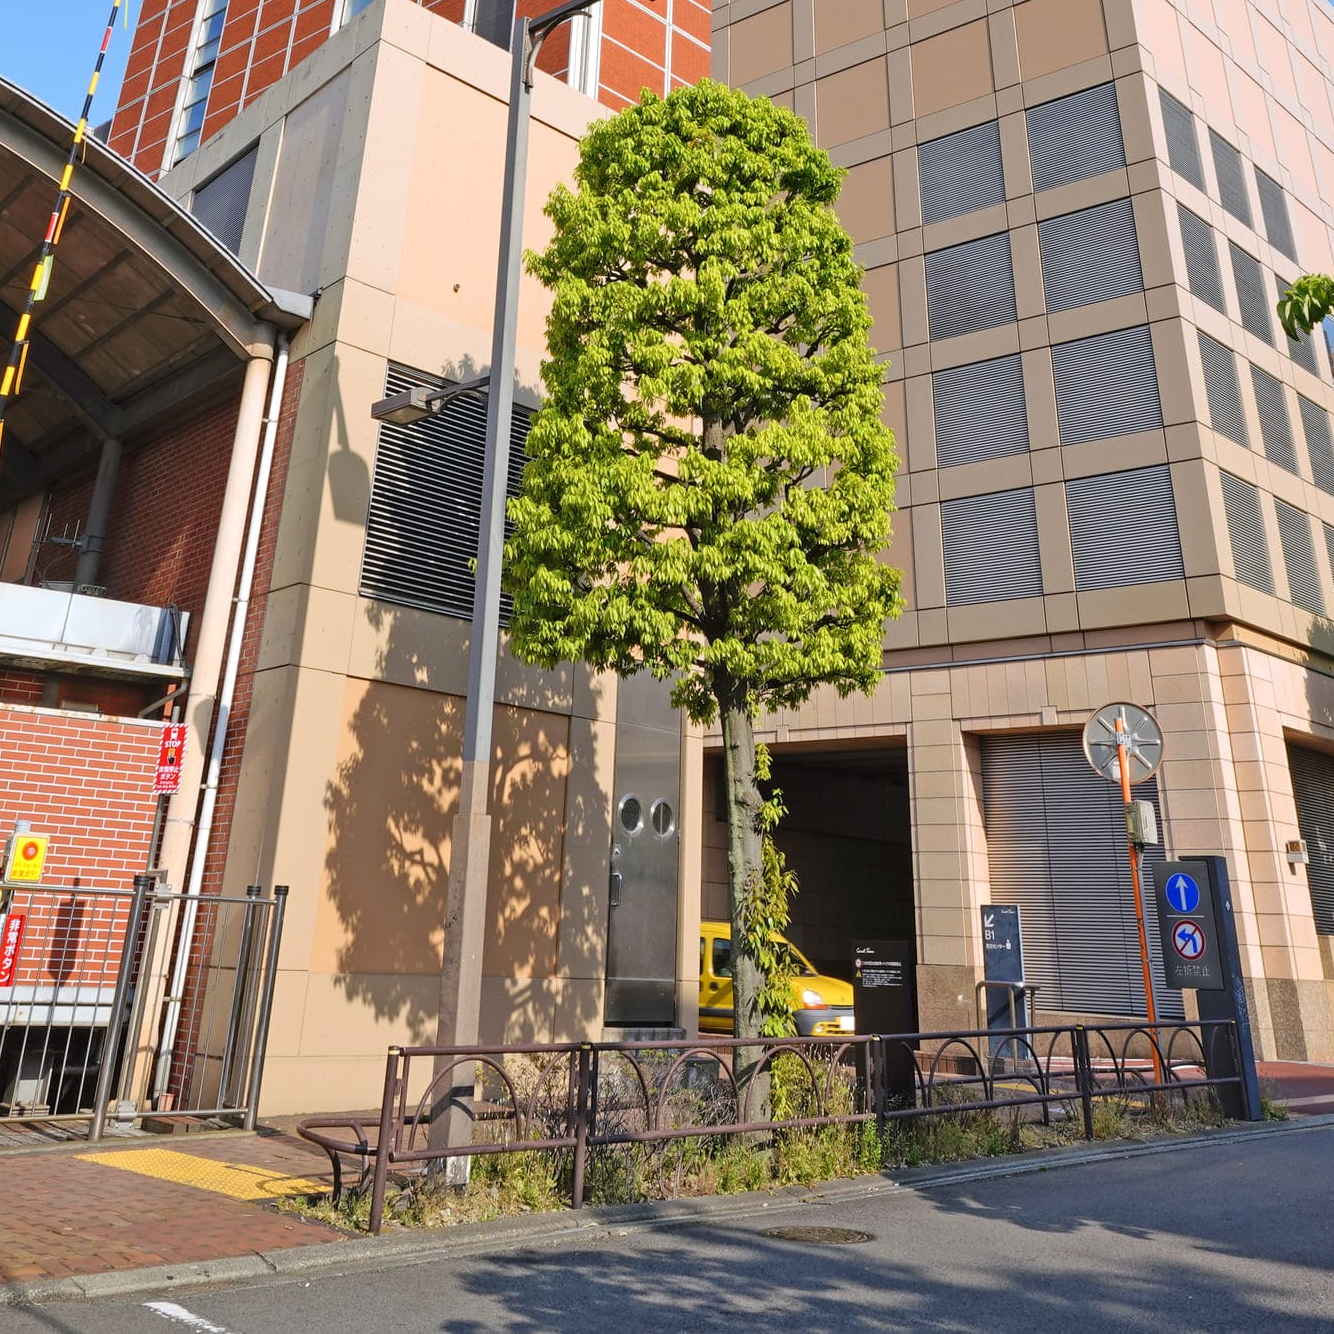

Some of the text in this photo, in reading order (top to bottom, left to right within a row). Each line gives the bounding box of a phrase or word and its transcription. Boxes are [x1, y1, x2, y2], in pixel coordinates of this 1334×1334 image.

[984, 929, 995, 941] B1
[0, 918, 21, 983] 非常ボタン
[1175, 965, 1212, 977] 左折禁止
